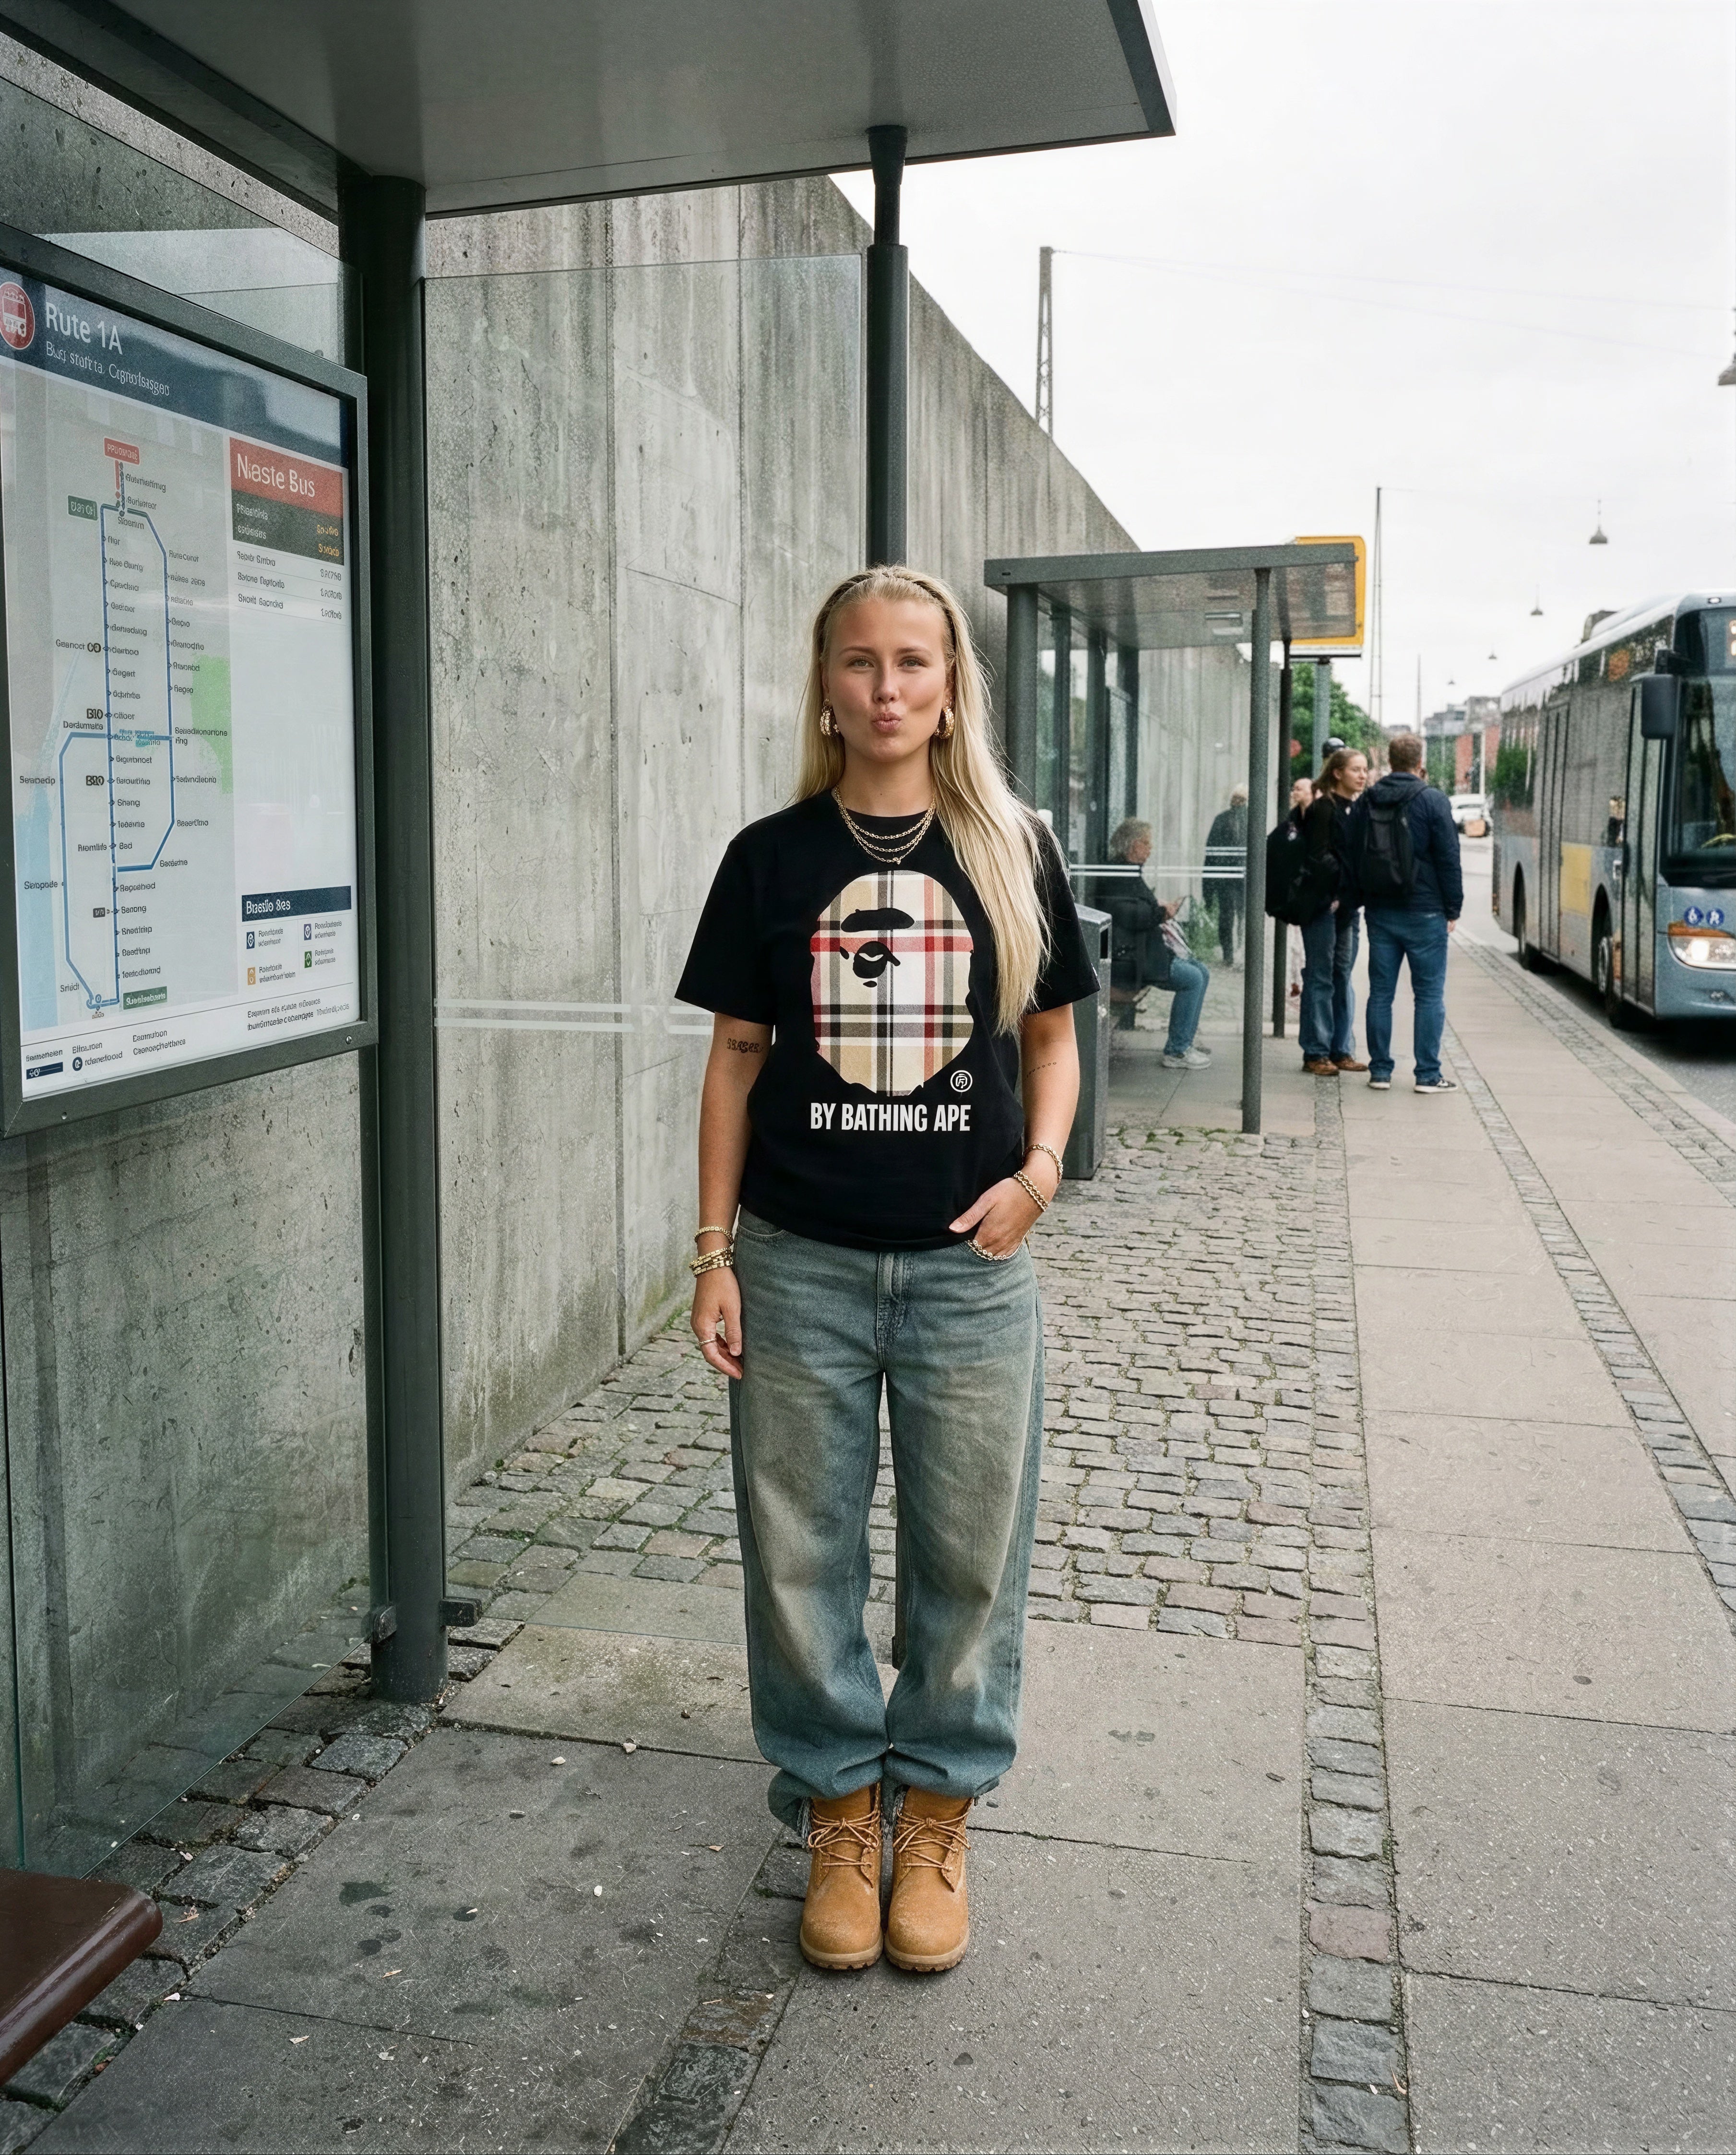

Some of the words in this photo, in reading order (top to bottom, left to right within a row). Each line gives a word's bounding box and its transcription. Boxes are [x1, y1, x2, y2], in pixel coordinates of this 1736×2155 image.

[46, 302, 91, 343] Rute
[97, 320, 123, 355] 1A
[289, 469, 315, 497] Bus
[810, 1102, 836, 1130] BY
[841, 1103, 928, 1132] BATHING
[933, 1104, 971, 1132] APE
